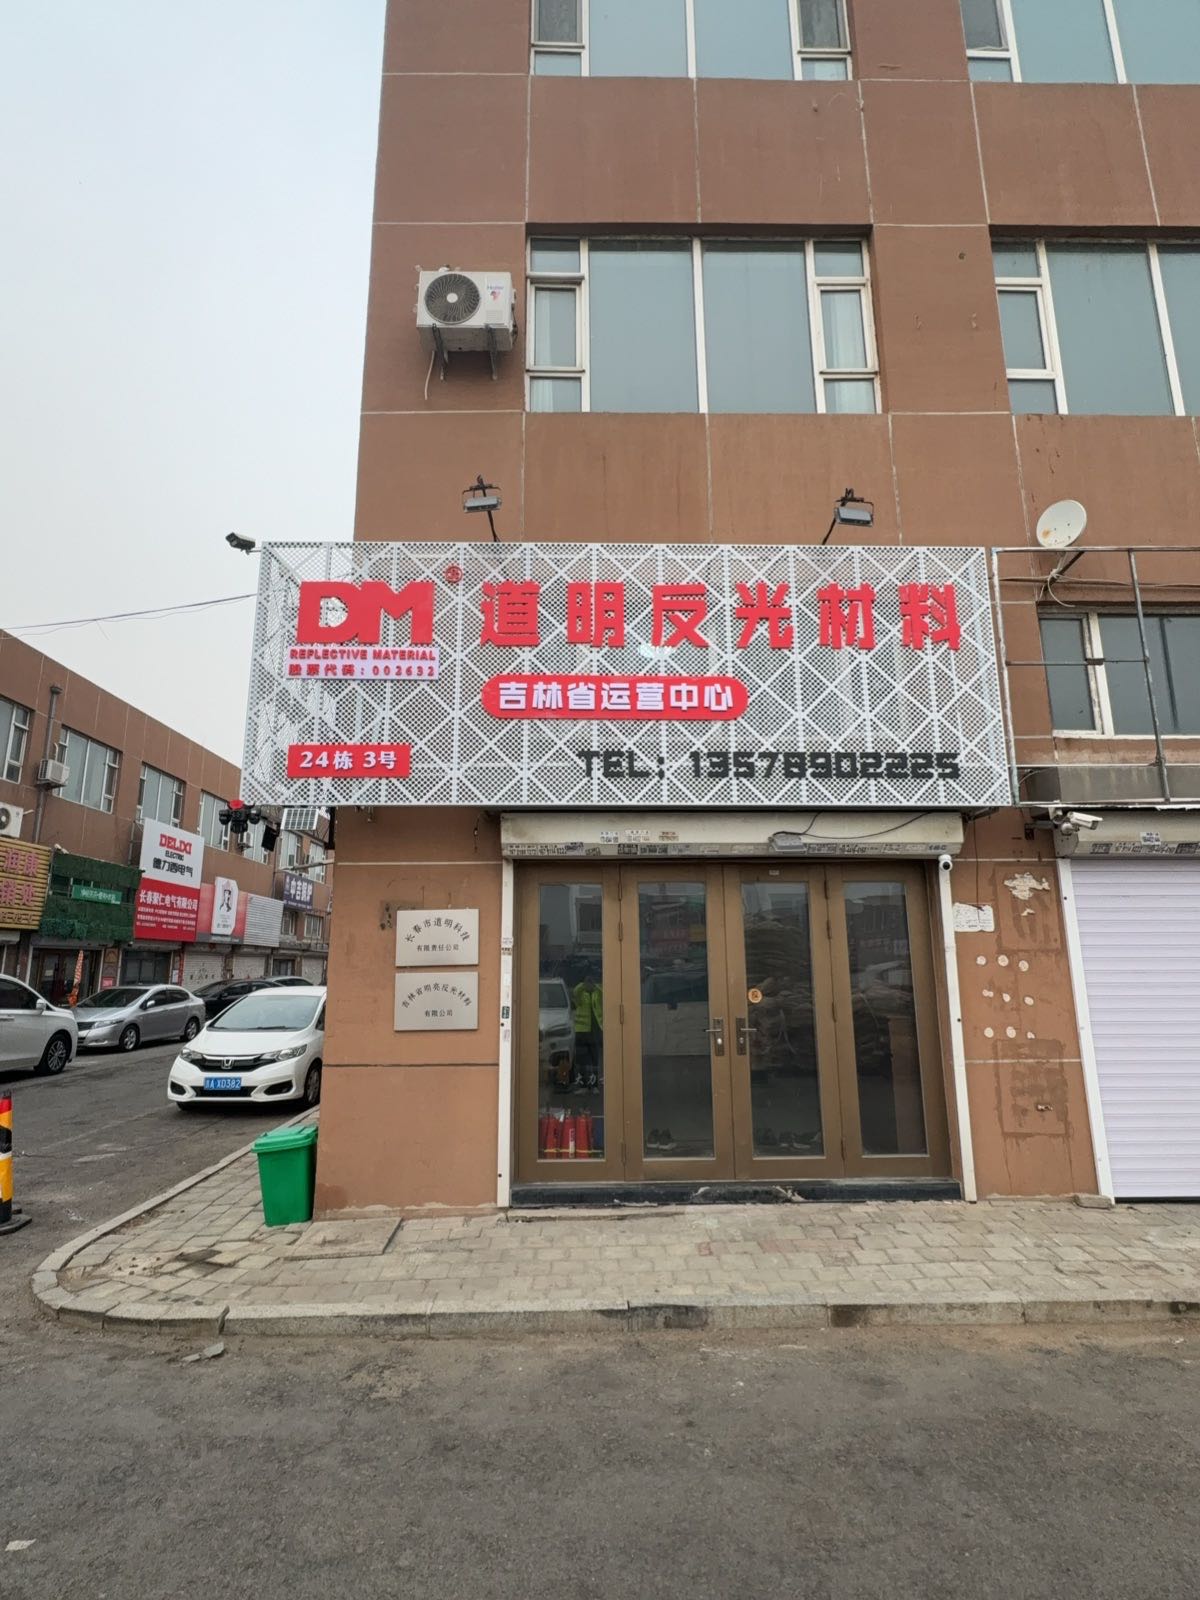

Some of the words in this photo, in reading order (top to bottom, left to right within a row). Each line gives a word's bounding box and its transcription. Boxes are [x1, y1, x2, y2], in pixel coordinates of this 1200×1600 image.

[296, 580, 434, 645] DM
[480, 580, 960, 650] 道明反光材料
[289, 648, 368, 660] REFLECTIVE
[372, 649, 436, 661] MATERIAL
[499, 682, 734, 711] 吉林省运营中心
[299, 750, 353, 770] 24栋
[363, 750, 397, 770] 3号
[690, 752, 960, 780] 13578902225
[159, 833, 193, 855] DELIXI
[424, 1009, 453, 1018] 有限公司
